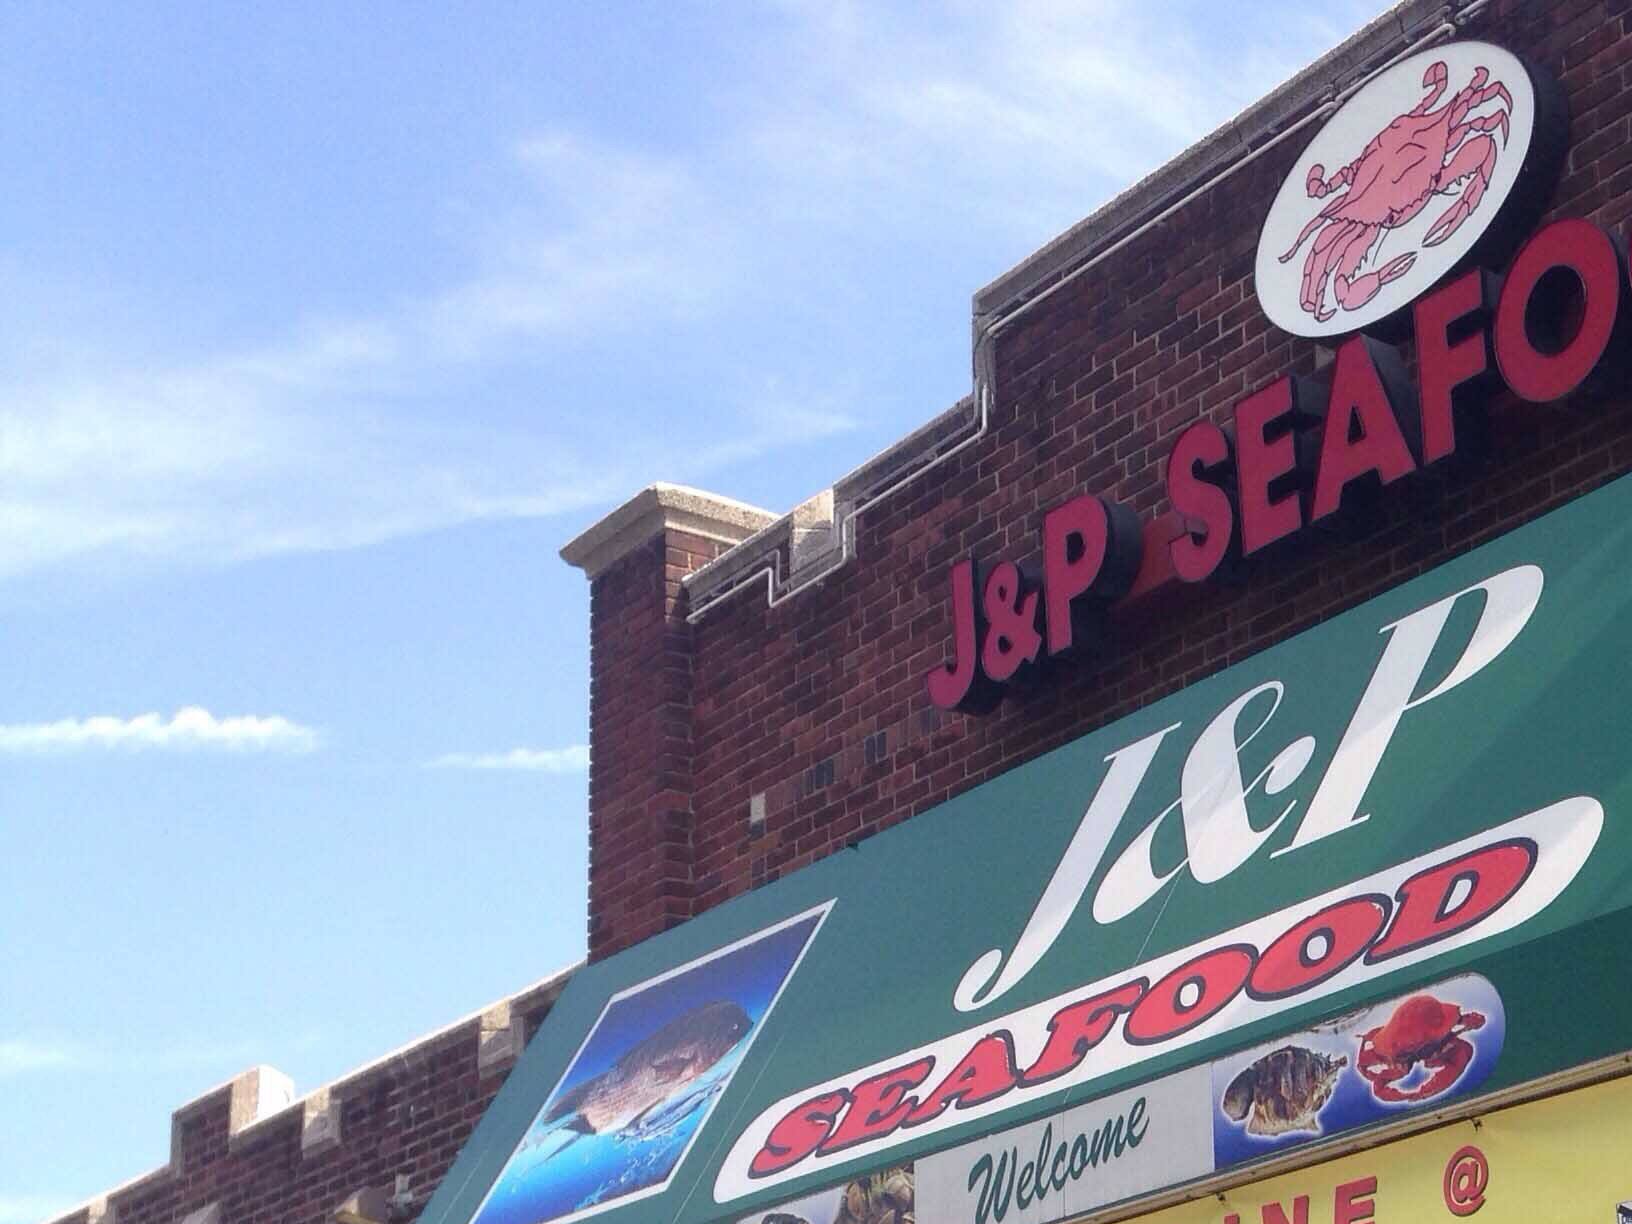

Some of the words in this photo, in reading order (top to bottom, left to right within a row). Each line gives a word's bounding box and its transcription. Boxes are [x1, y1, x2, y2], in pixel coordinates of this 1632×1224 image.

[927, 495, 1112, 711] J&P
[953, 564, 1544, 1012] J&P
[748, 836, 1538, 1179] SEAFOOD
[1443, 1145, 1489, 1217] @
